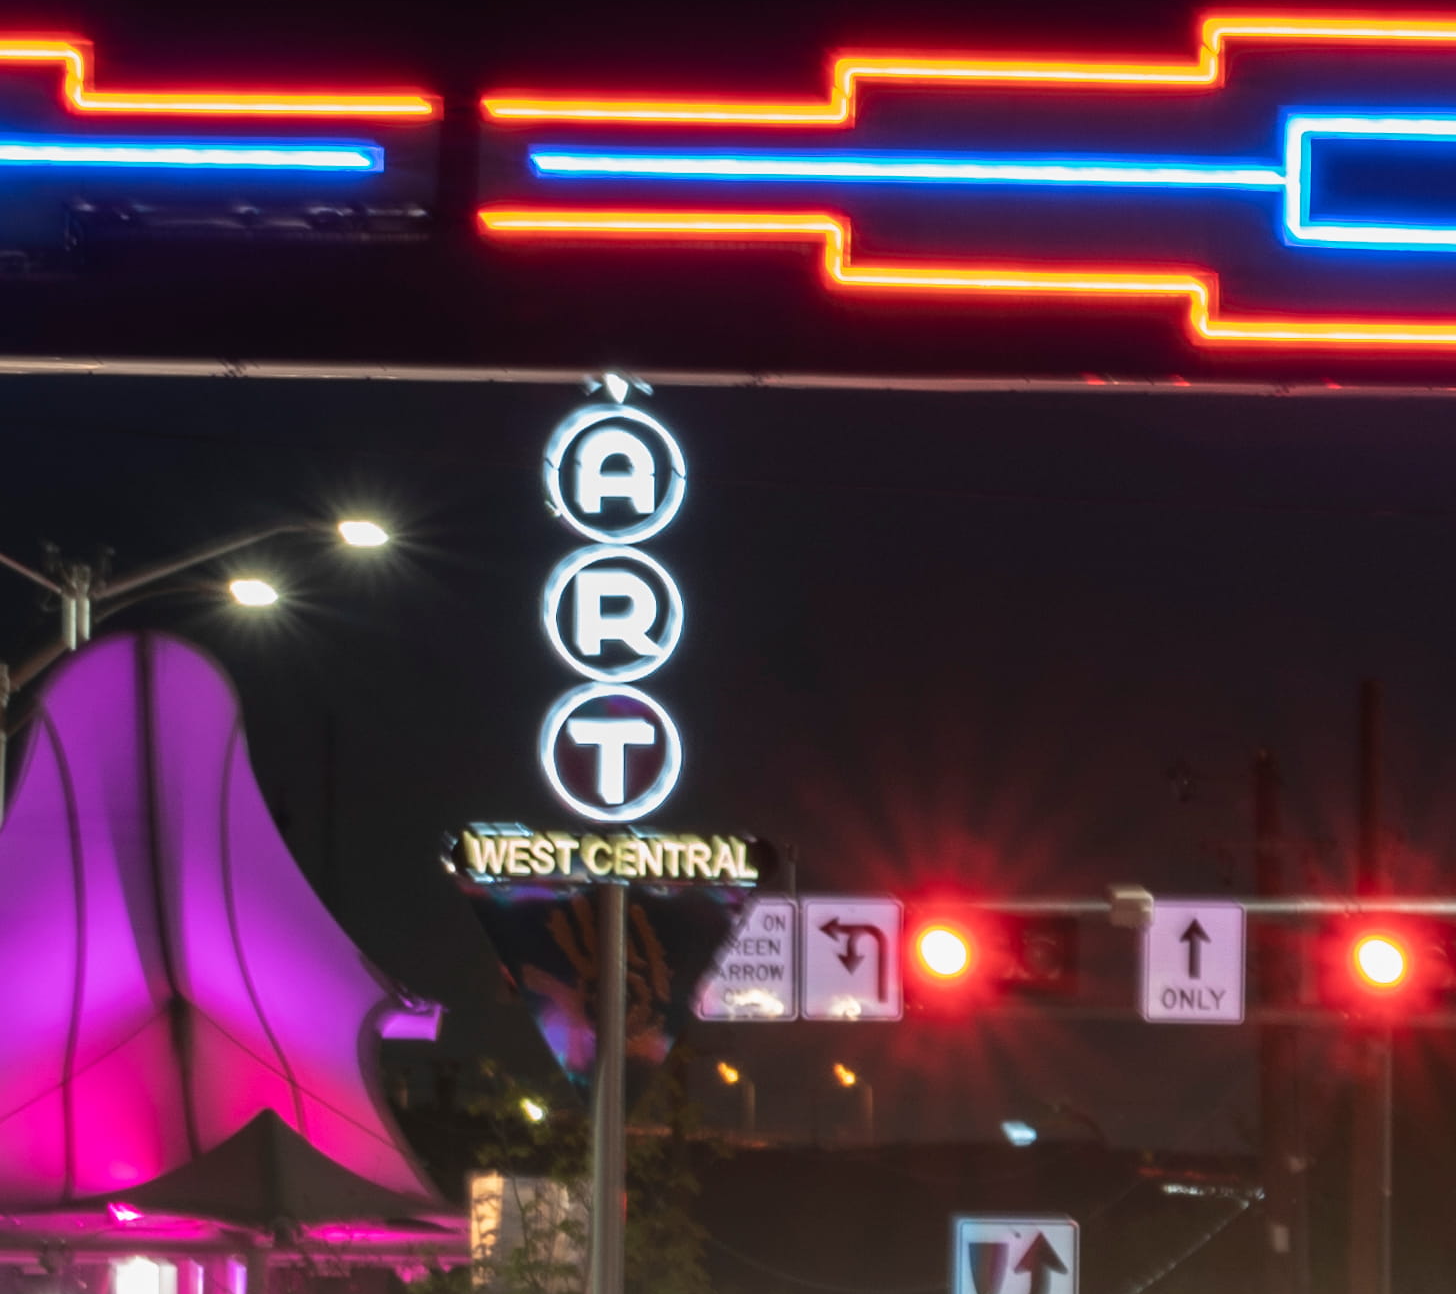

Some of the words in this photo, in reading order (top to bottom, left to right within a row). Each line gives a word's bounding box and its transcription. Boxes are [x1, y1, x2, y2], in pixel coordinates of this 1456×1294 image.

[566, 426, 664, 806] ART
[464, 832, 580, 876] WEST
[582, 834, 759, 881] CENTRAL
[727, 939, 781, 956] REEN
[1161, 989, 1227, 1012] ONLY
